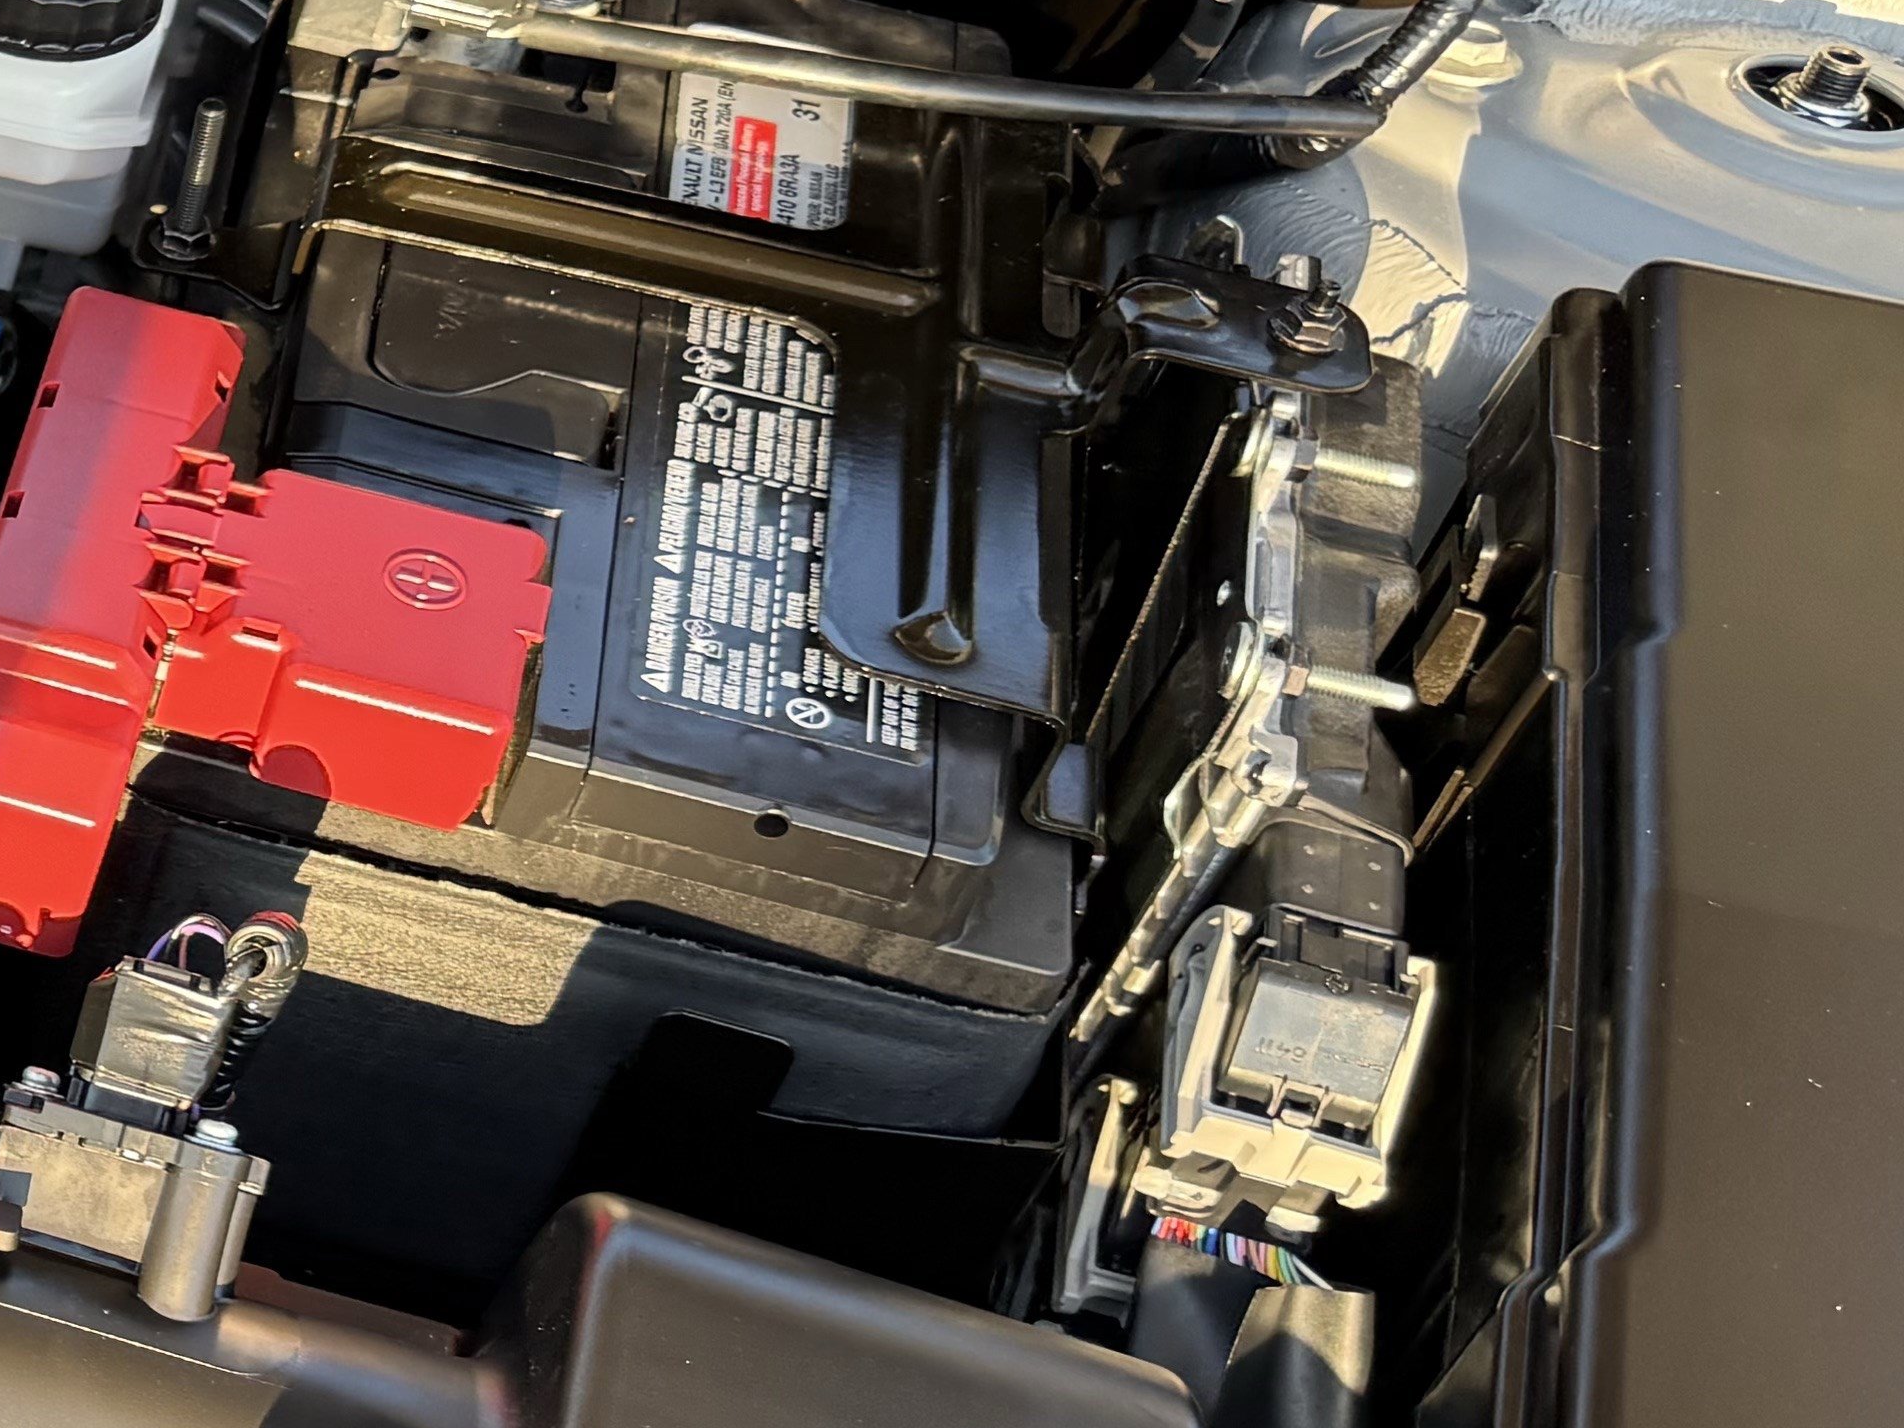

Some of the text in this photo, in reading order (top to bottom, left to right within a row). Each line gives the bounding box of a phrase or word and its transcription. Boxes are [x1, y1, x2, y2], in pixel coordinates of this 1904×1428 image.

[790, 96, 821, 123] 31
[680, 95, 709, 206] ENAULT NISSAN
[775, 150, 801, 198] 6RA3A
[644, 457, 695, 672] DANGER/POISON PELIGRO/VENENO
